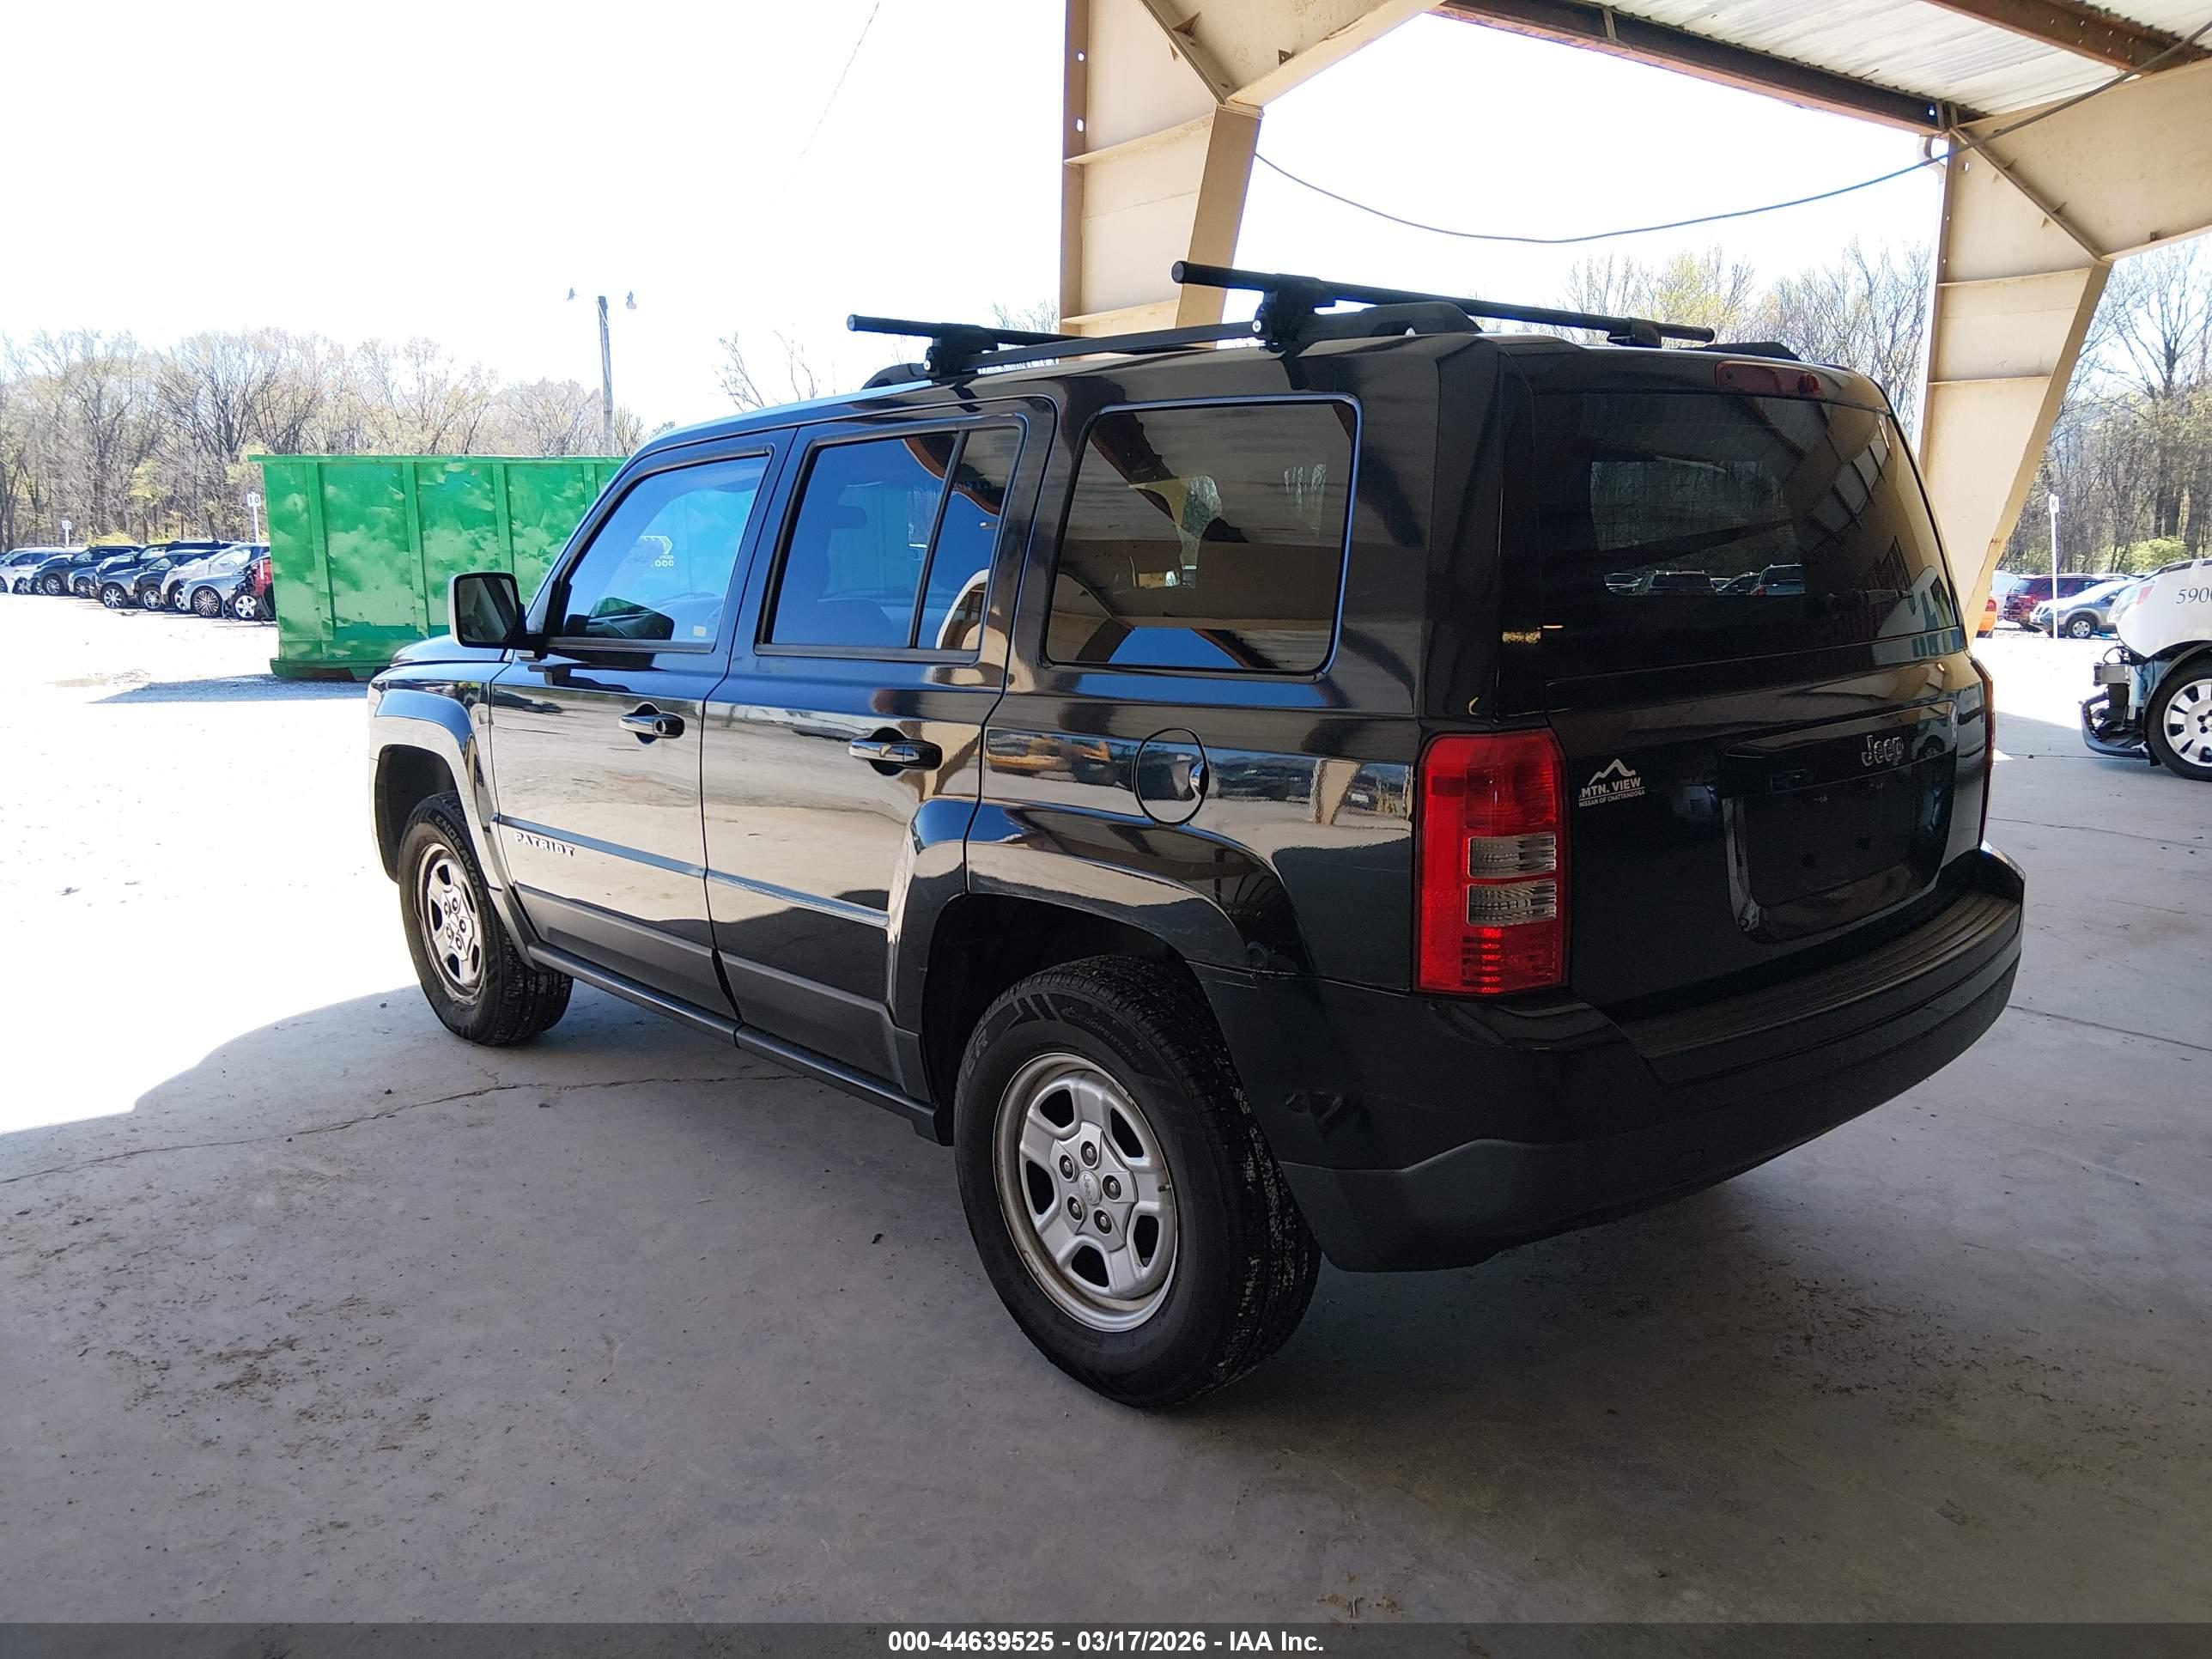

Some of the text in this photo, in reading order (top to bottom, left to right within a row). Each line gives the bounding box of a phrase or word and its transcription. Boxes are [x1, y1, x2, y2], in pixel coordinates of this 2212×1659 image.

[1861, 734, 1905, 767] Jeep
[1578, 798, 1599, 808] NISSAN
[1607, 789, 1646, 803] CHATTANOOGA
[1581, 776, 1642, 799] MTN. VIEW
[434, 814, 484, 901] ENDEAVOR
[514, 831, 576, 858] PATRIOT
